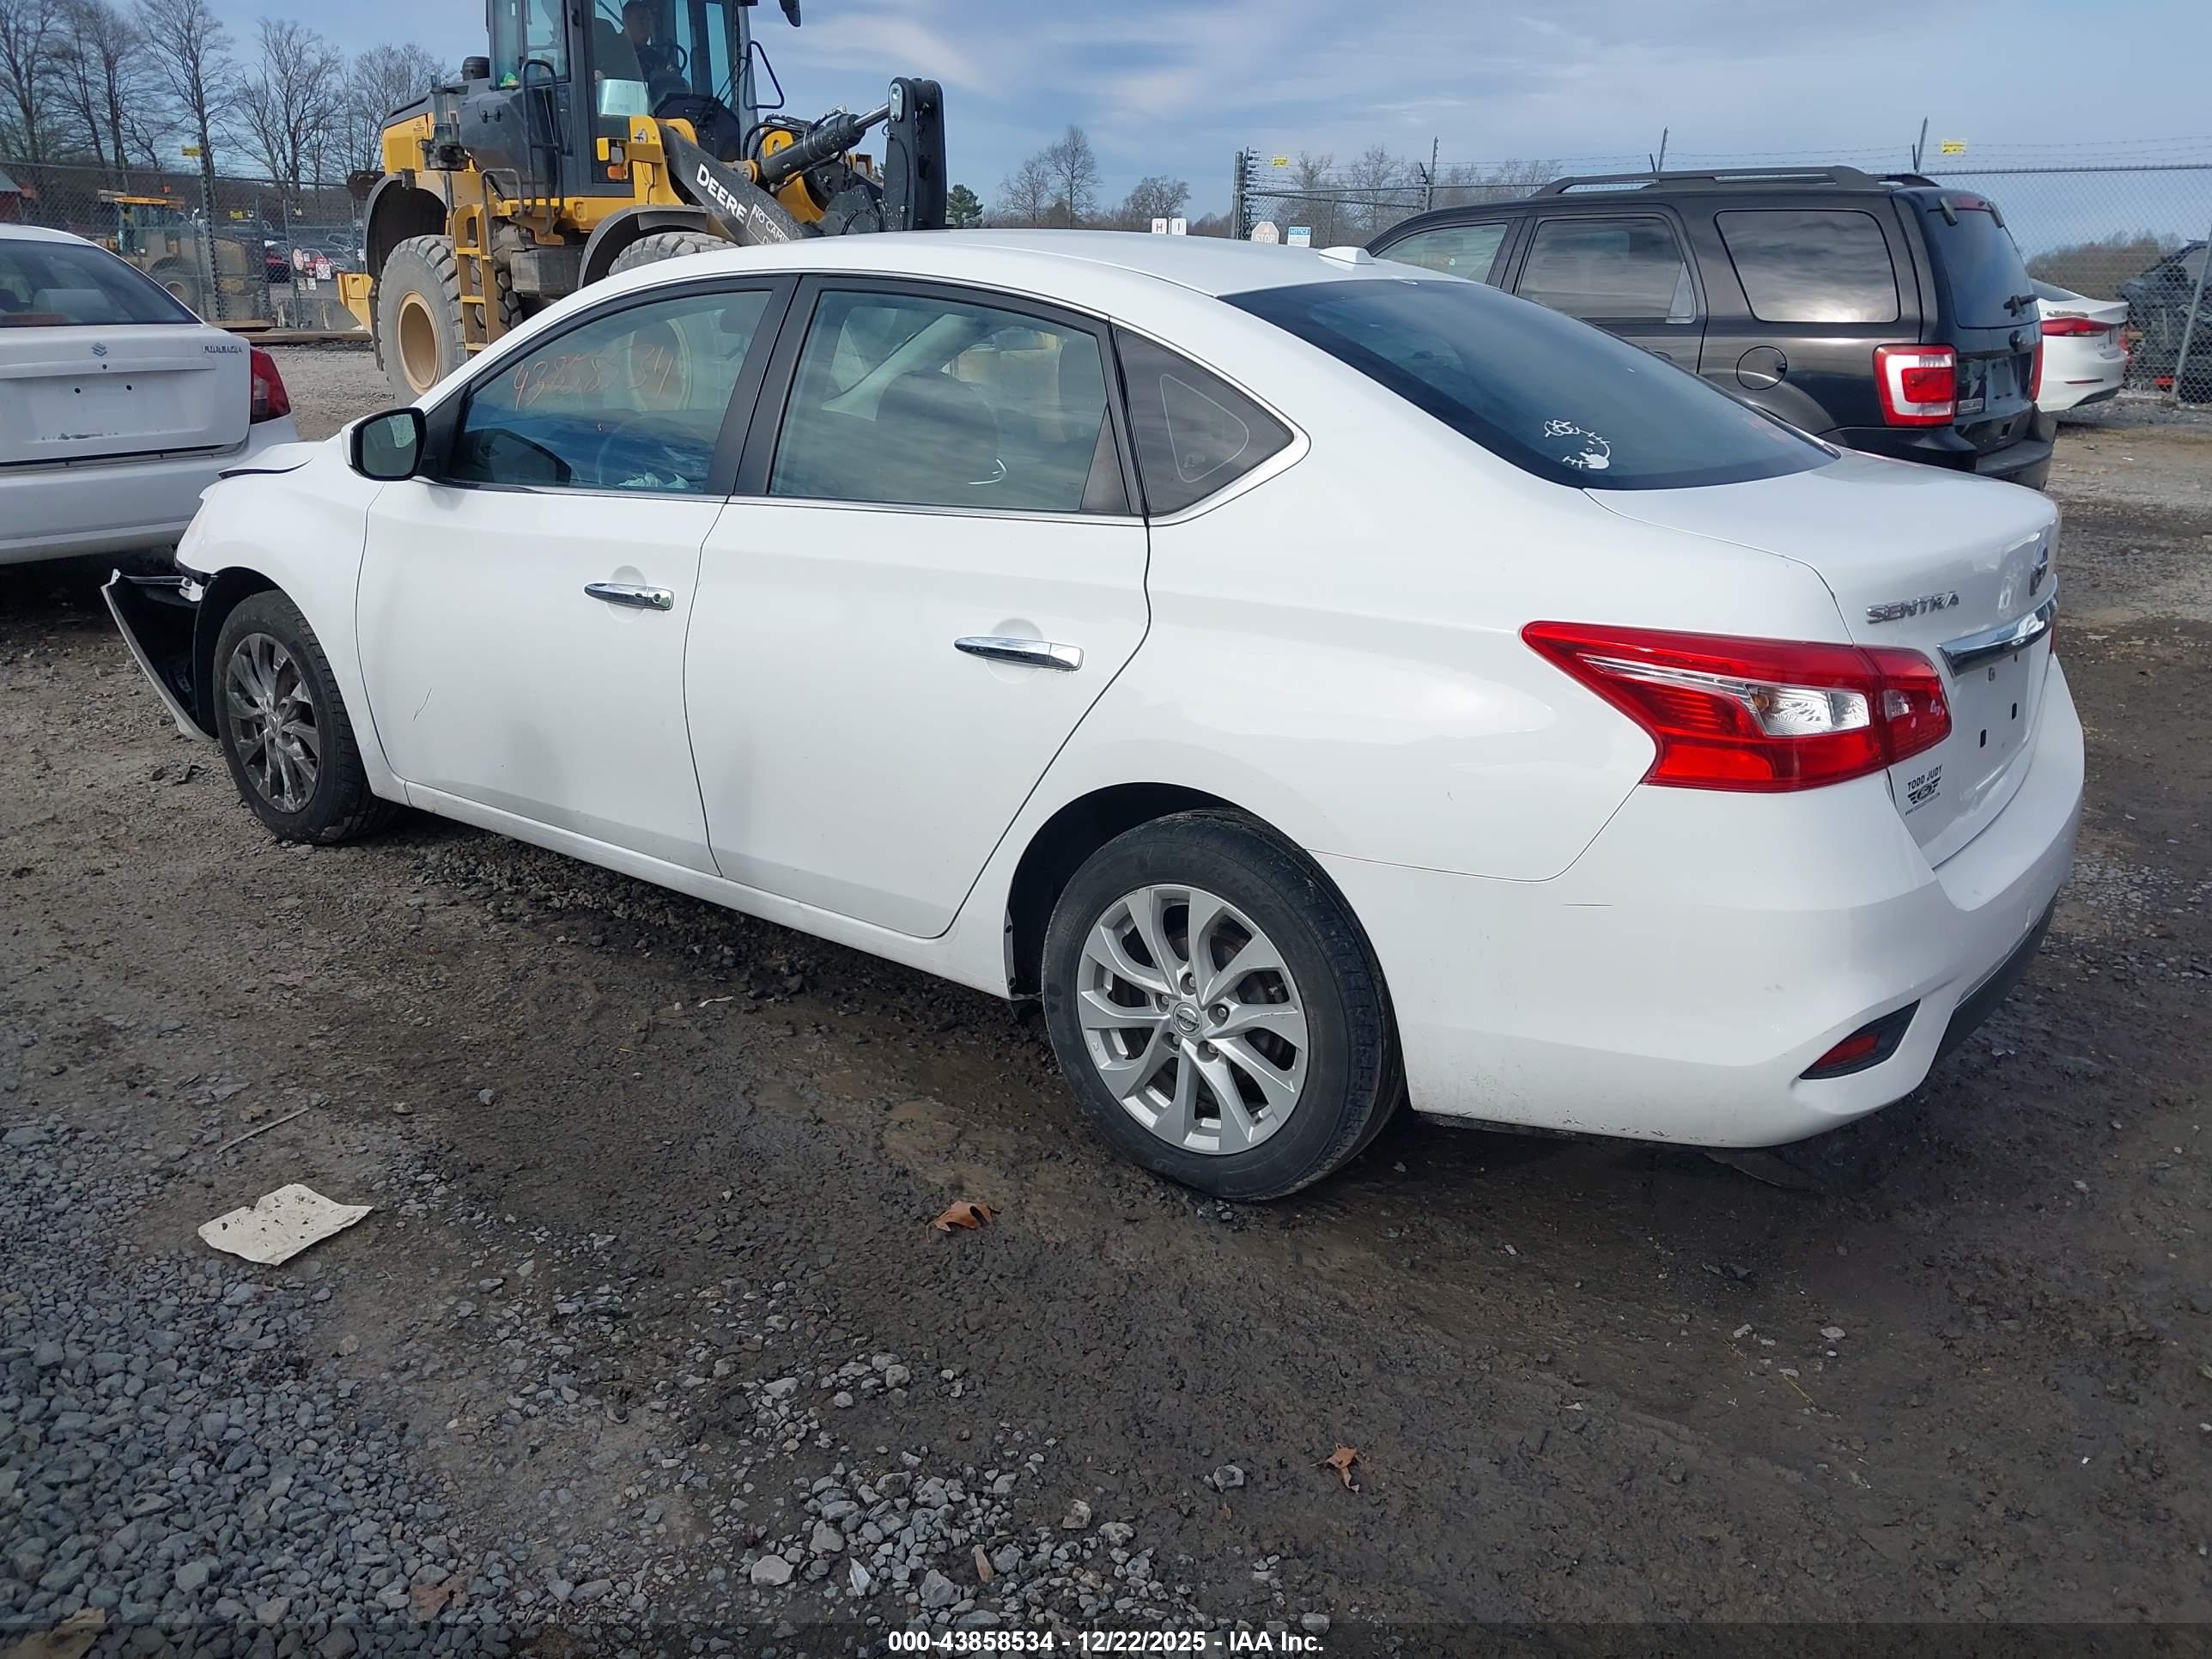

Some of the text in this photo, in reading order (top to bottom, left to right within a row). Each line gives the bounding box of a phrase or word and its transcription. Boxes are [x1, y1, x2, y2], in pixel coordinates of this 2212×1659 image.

[696, 163, 747, 225] DEERE
[752, 204, 764, 222] NO
[1156, 222, 1163, 233] H
[1255, 234, 1274, 244] STOP
[1866, 591, 1960, 624] SENTRA
[1908, 763, 1943, 792] TODD JUDY
